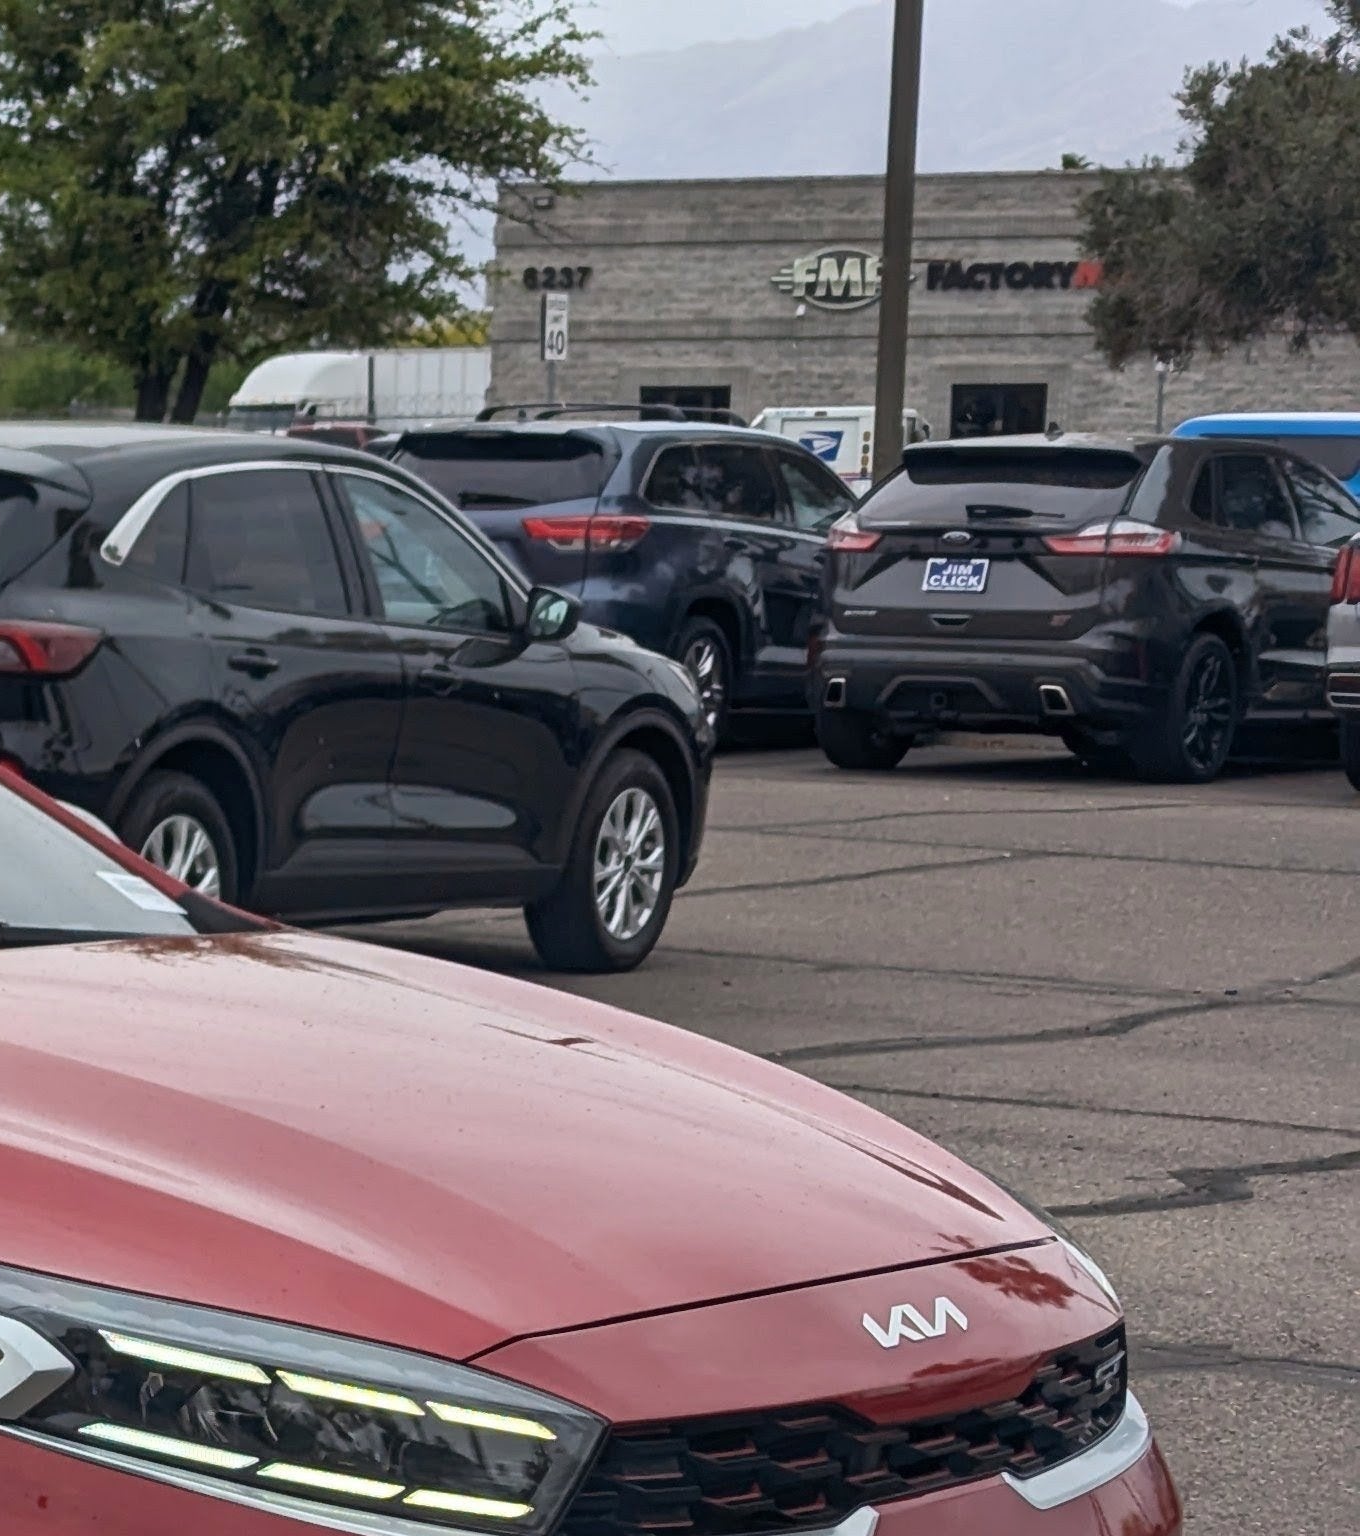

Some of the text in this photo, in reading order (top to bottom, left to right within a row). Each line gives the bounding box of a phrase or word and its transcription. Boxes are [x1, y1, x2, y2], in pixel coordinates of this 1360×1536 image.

[523, 266, 593, 290] 6237
[926, 260, 1079, 291] FACTORY
[547, 329, 565, 355] 40
[929, 575, 980, 587] CLICK
[942, 564, 973, 576] JIM
